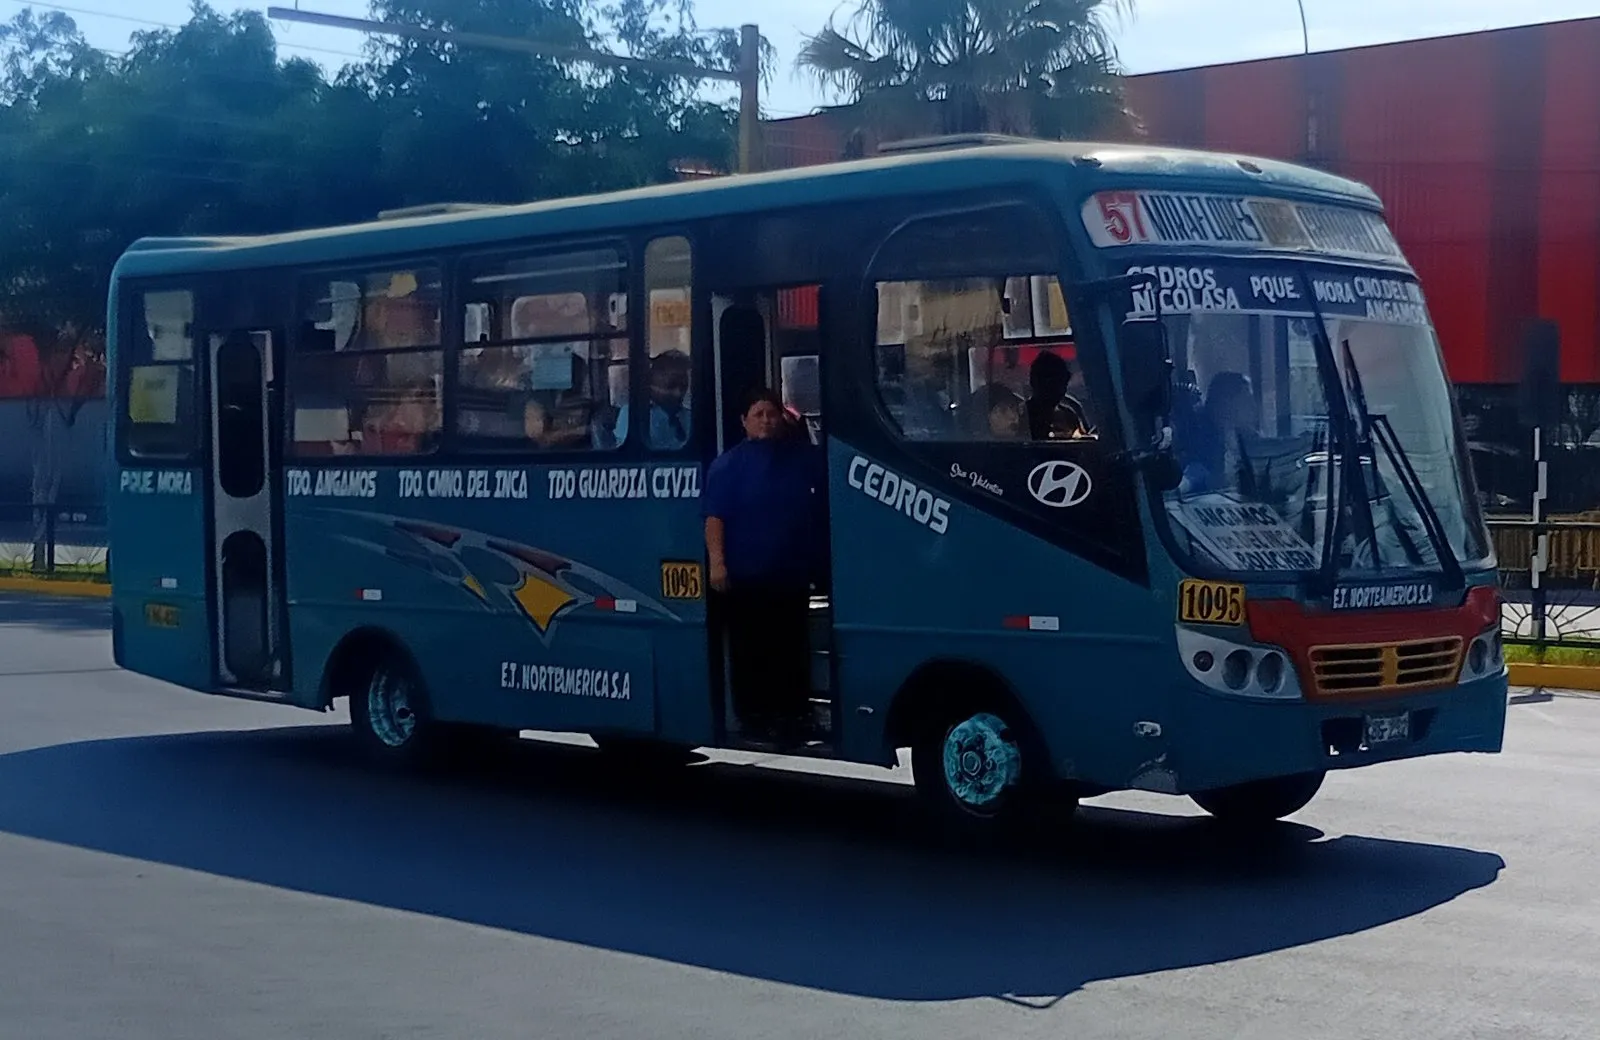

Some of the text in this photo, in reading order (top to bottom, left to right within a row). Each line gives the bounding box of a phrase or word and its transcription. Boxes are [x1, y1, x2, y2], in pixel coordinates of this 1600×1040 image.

[1098, 192, 1148, 243] 57
[1139, 194, 1263, 242] MIRAFLORES
[1313, 280, 1356, 303] MORA
[1365, 299, 1427, 325] ANGAMOS
[157, 470, 193, 495] MORA
[314, 470, 378, 497] ANGAMOS
[467, 470, 490, 498] DEL
[494, 470, 528, 498] INCA
[548, 467, 700, 499] TDO GUARDIA CIVIL
[848, 455, 951, 534] CEDROS
[1193, 506, 1278, 527] ANGAMOS
[664, 566, 699, 597] 1095
[1350, 584, 1418, 607] NORTEAMERICA
[1184, 582, 1241, 622] 1095
[522, 664, 609, 698] NORTEAMERICA
